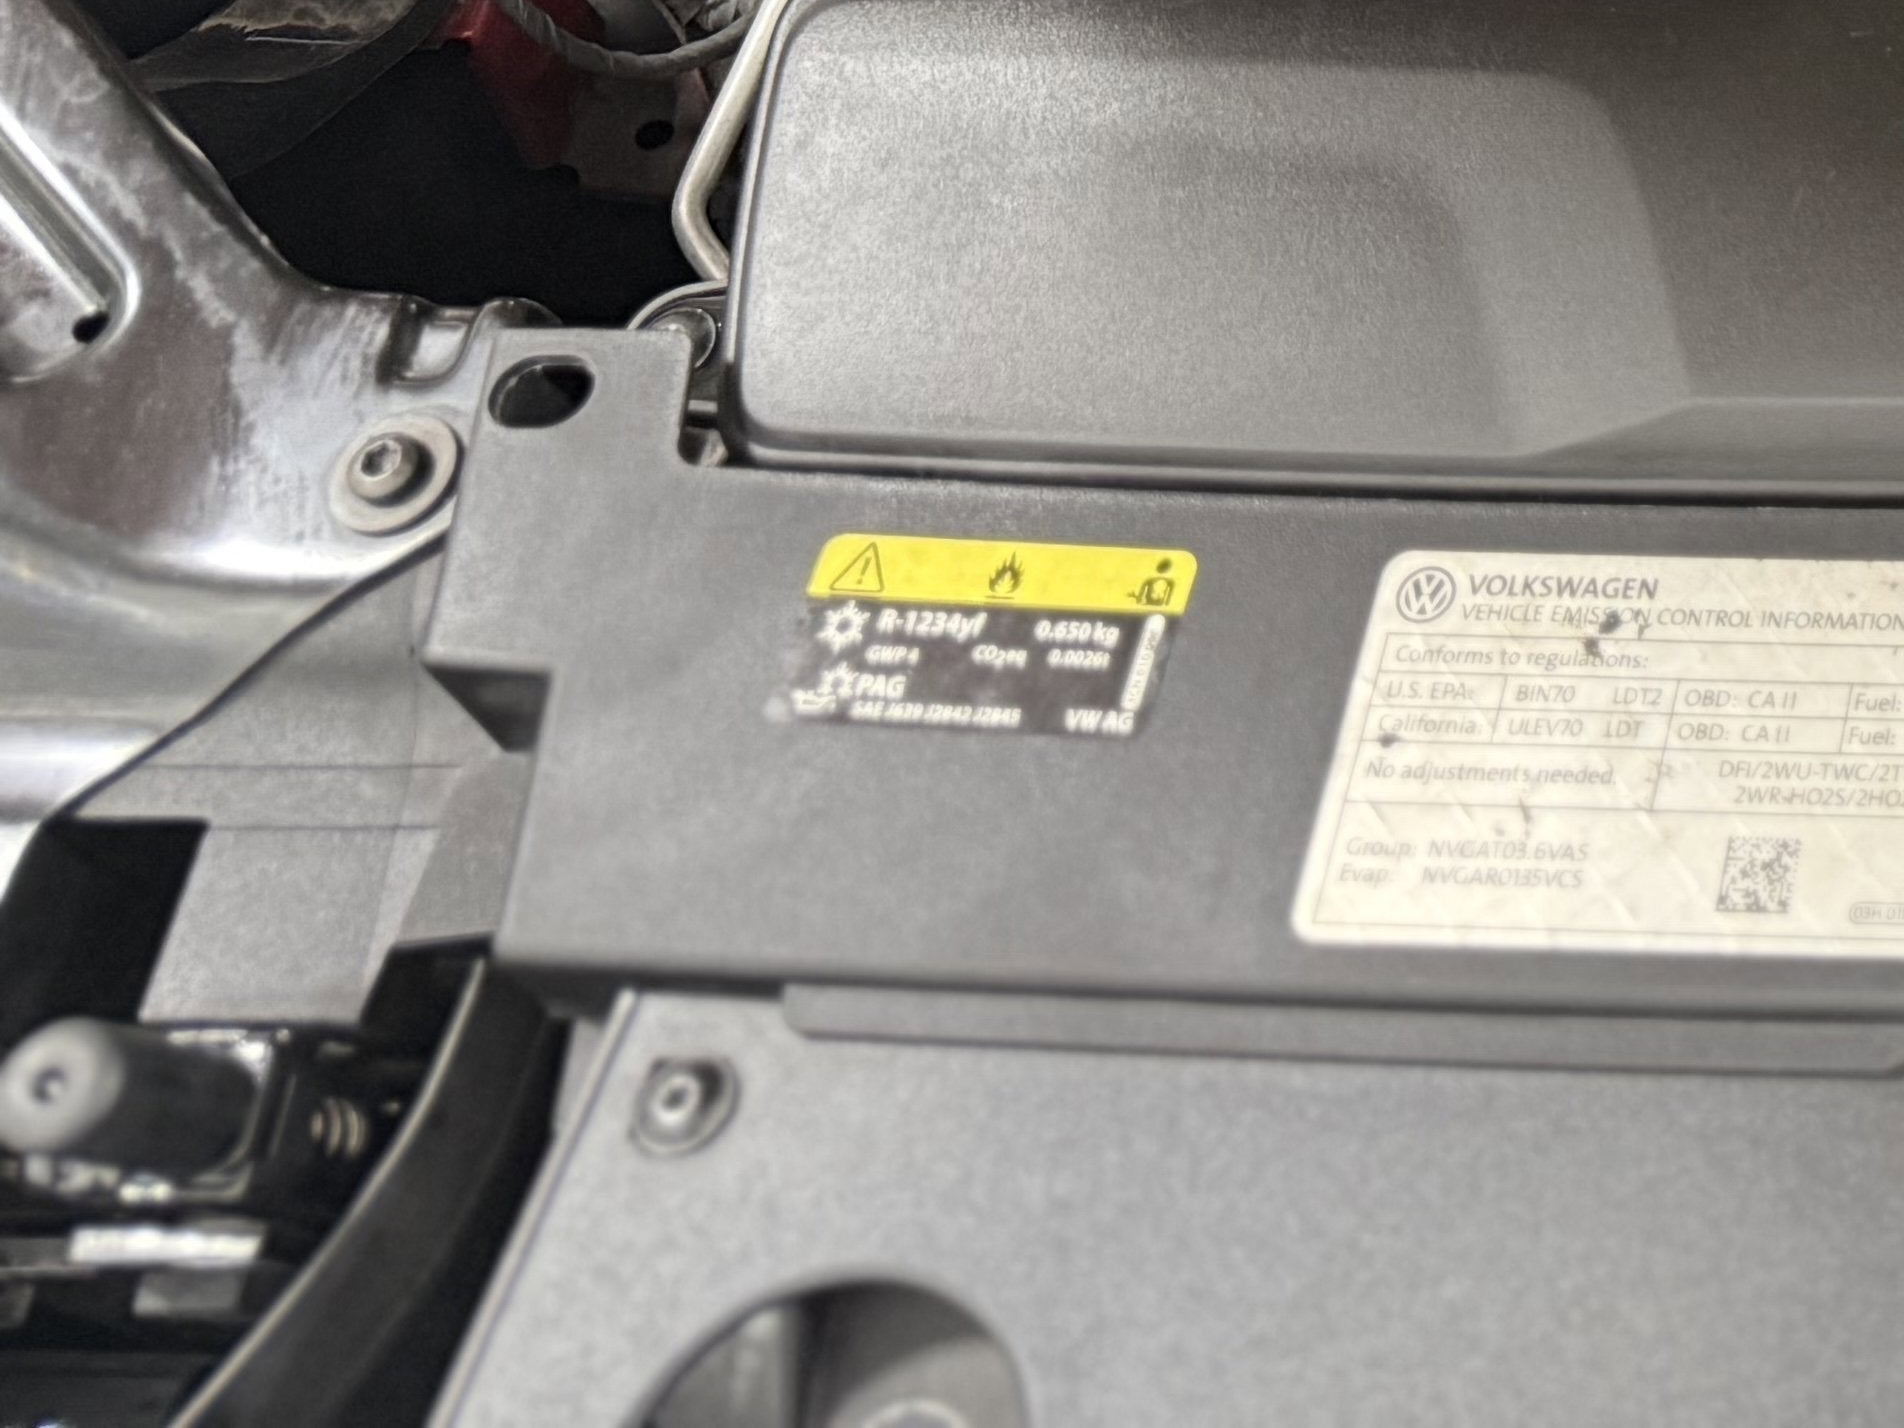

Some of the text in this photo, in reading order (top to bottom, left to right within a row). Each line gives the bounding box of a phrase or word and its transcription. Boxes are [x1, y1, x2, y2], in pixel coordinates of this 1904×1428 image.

[1469, 574, 1659, 600] VOLKSWAGEN
[1462, 603, 1543, 622] VEHICLE
[1550, 605, 1651, 628] EMISSON
[1656, 607, 1754, 628] CONTROL
[1034, 618, 1092, 644] 0.650
[1093, 622, 1120, 649] kg
[865, 647, 906, 666] GWP
[1395, 645, 1493, 665] Conforms
[1500, 650, 1520, 666] to
[856, 674, 906, 698] PAG
[1516, 685, 1663, 706] BIN70 LDT2
[1684, 689, 1777, 710] OBD: CA
[1854, 692, 1902, 713] Fuel:
[1064, 709, 1134, 735] VW AG
[1508, 717, 1583, 737] ULEV70
[1677, 723, 1770, 743] OBD: CA
[1849, 727, 1896, 746] Fuel:
[1366, 760, 1395, 779] No
[1400, 761, 1531, 785] adjustments
